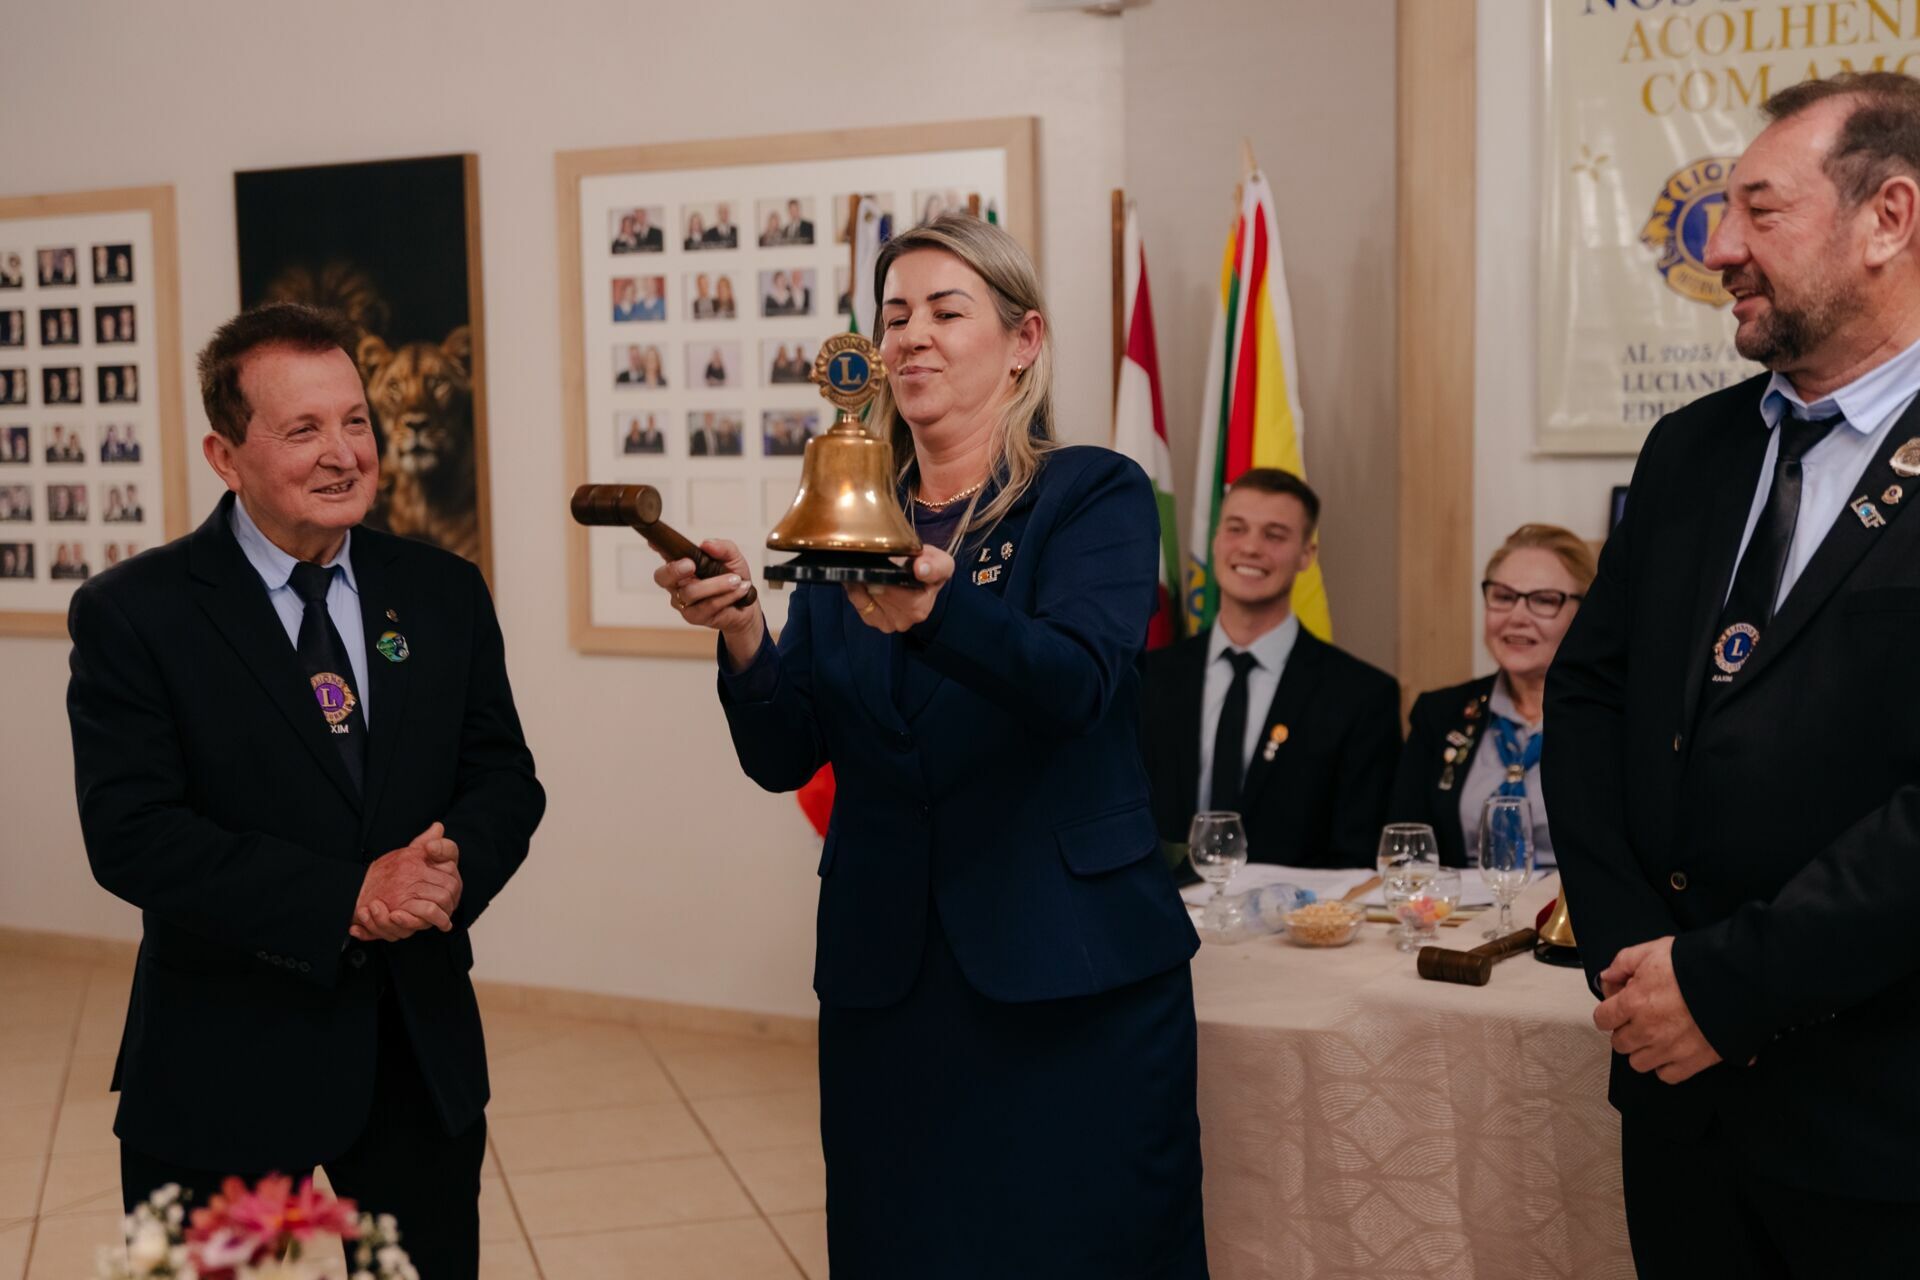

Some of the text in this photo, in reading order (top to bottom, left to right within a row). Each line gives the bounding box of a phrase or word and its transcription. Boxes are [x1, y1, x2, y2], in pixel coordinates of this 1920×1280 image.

[1641, 63, 1775, 117] COM
[827, 338, 868, 353] LIONS
[838, 356, 861, 385] L
[1731, 639, 1743, 656] L
[320, 688, 337, 707] L
